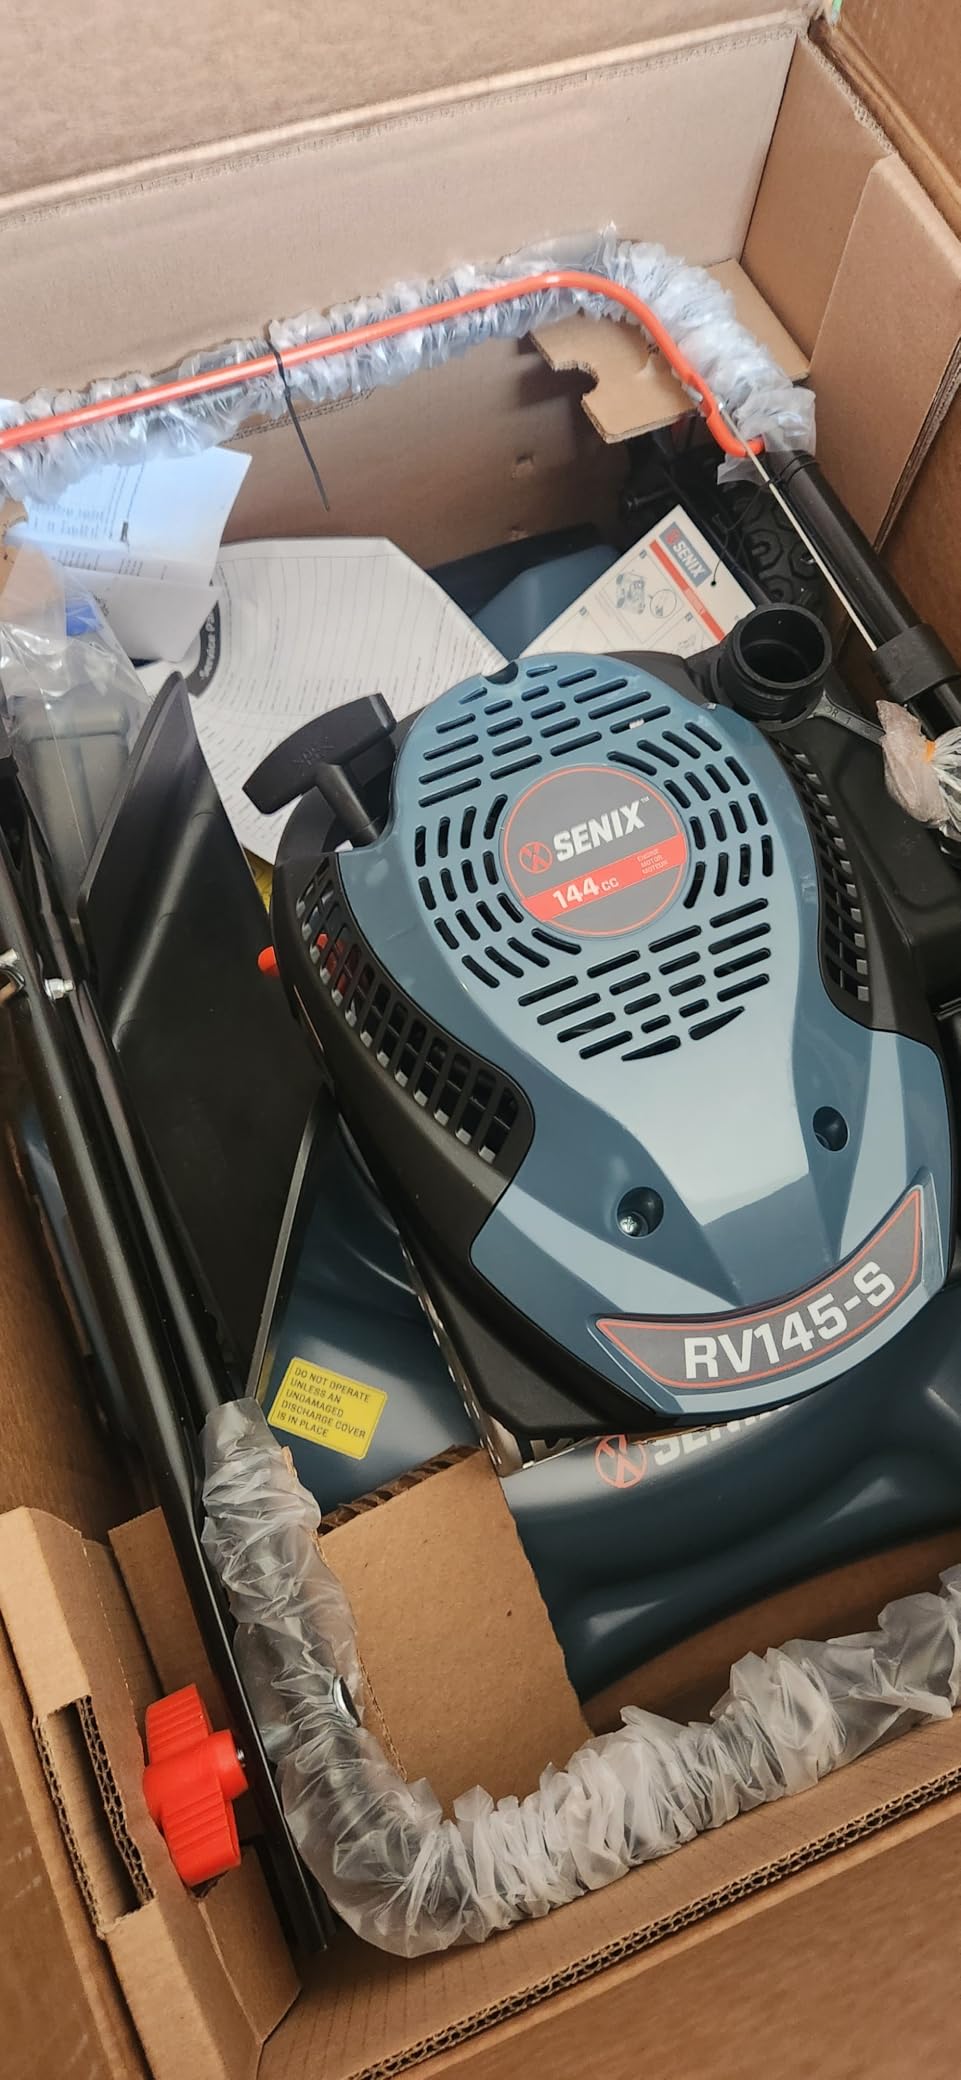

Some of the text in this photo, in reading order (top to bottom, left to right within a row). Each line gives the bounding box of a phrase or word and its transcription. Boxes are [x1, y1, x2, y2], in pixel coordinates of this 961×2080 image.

[672, 540, 707, 579] SENIX
[553, 800, 646, 863] SENIX
[641, 855, 664, 868] MOTOR
[552, 877, 600, 909] 144
[684, 1261, 896, 1379] RV145-S
[290, 1378, 342, 1405] UNLESS AN
[295, 1367, 370, 1403] DO NOT OPERATE
[281, 1400, 366, 1439] DISCHARGE COVER
[286, 1389, 344, 1418] UNDAMAGED
[276, 1411, 329, 1438] IS IN PLACE
